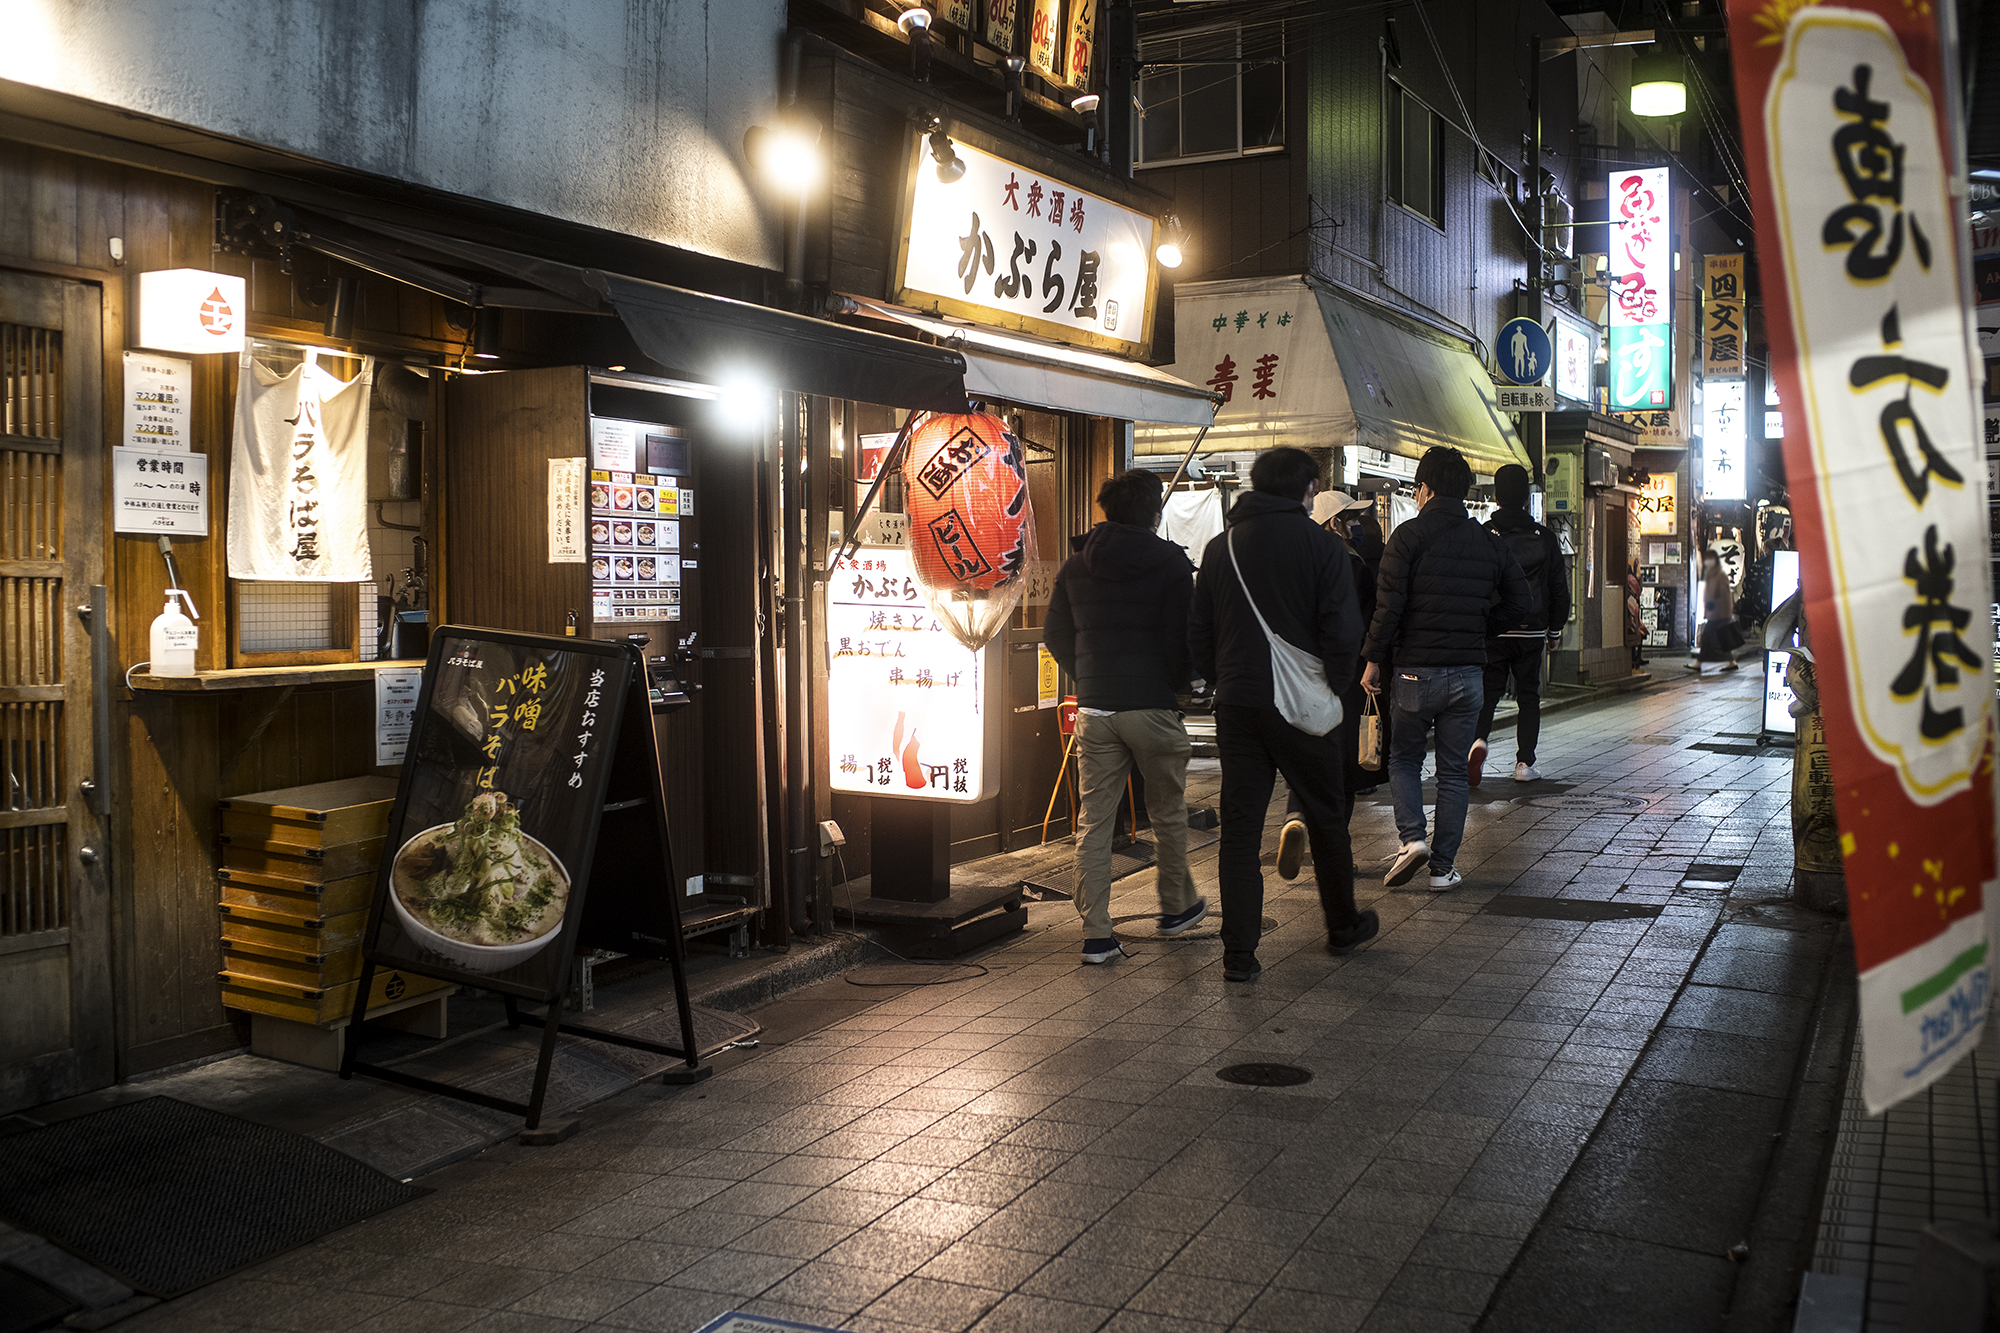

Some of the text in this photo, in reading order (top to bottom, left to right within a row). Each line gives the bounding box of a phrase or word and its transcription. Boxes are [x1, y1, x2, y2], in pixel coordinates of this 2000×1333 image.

[1002, 172, 1085, 233] 大衆酒場
[958, 211, 1101, 320] かぶら屋
[1212, 310, 1293, 333] 中華そば
[1709, 273, 1739, 362] 四文屋
[1206, 354, 1279, 403] 青葉
[1616, 327, 1665, 406] すし
[136, 392, 179, 404] マスク着用の
[1502, 392, 1550, 406] 自転車を除く
[136, 424, 179, 436] マスク着用の
[136, 458, 184, 474] 営業時間
[935, 514, 981, 578] ビール
[836, 560, 887, 571] 大衆酒場
[870, 611, 942, 632] 焼きとん
[837, 637, 906, 658] 黒おでん
[890, 667, 962, 688] 串揚げ
[514, 662, 548, 731] 味噌
[476, 674, 520, 789] バラそば
[568, 669, 606, 788] 当店おすすめ
[953, 758, 968, 793] 税抜
